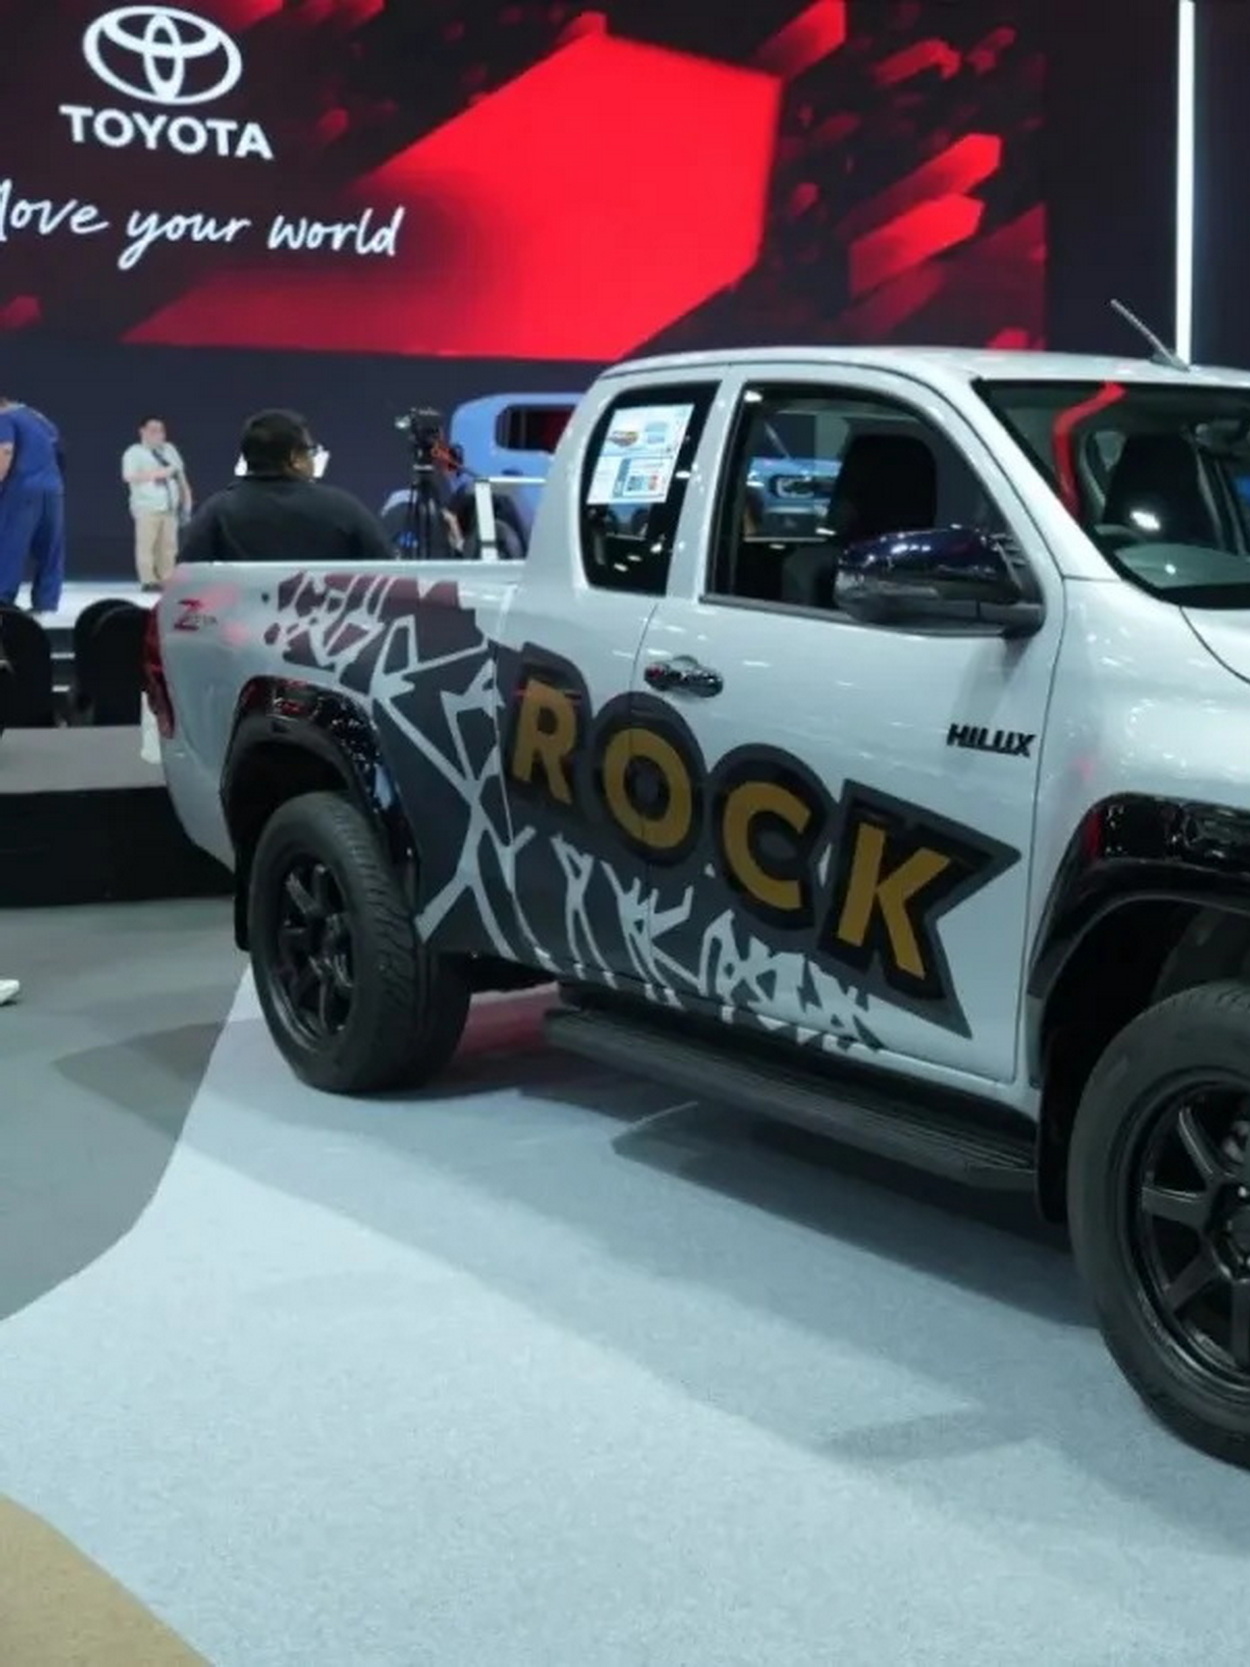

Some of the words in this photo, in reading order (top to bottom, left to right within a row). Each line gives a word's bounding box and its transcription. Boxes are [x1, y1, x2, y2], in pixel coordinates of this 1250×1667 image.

[59, 104, 275, 160] TOYOTA
[117, 209, 251, 271] your
[267, 206, 405, 257] world
[946, 723, 1036, 759] HILUX
[511, 678, 952, 981] ROCK
